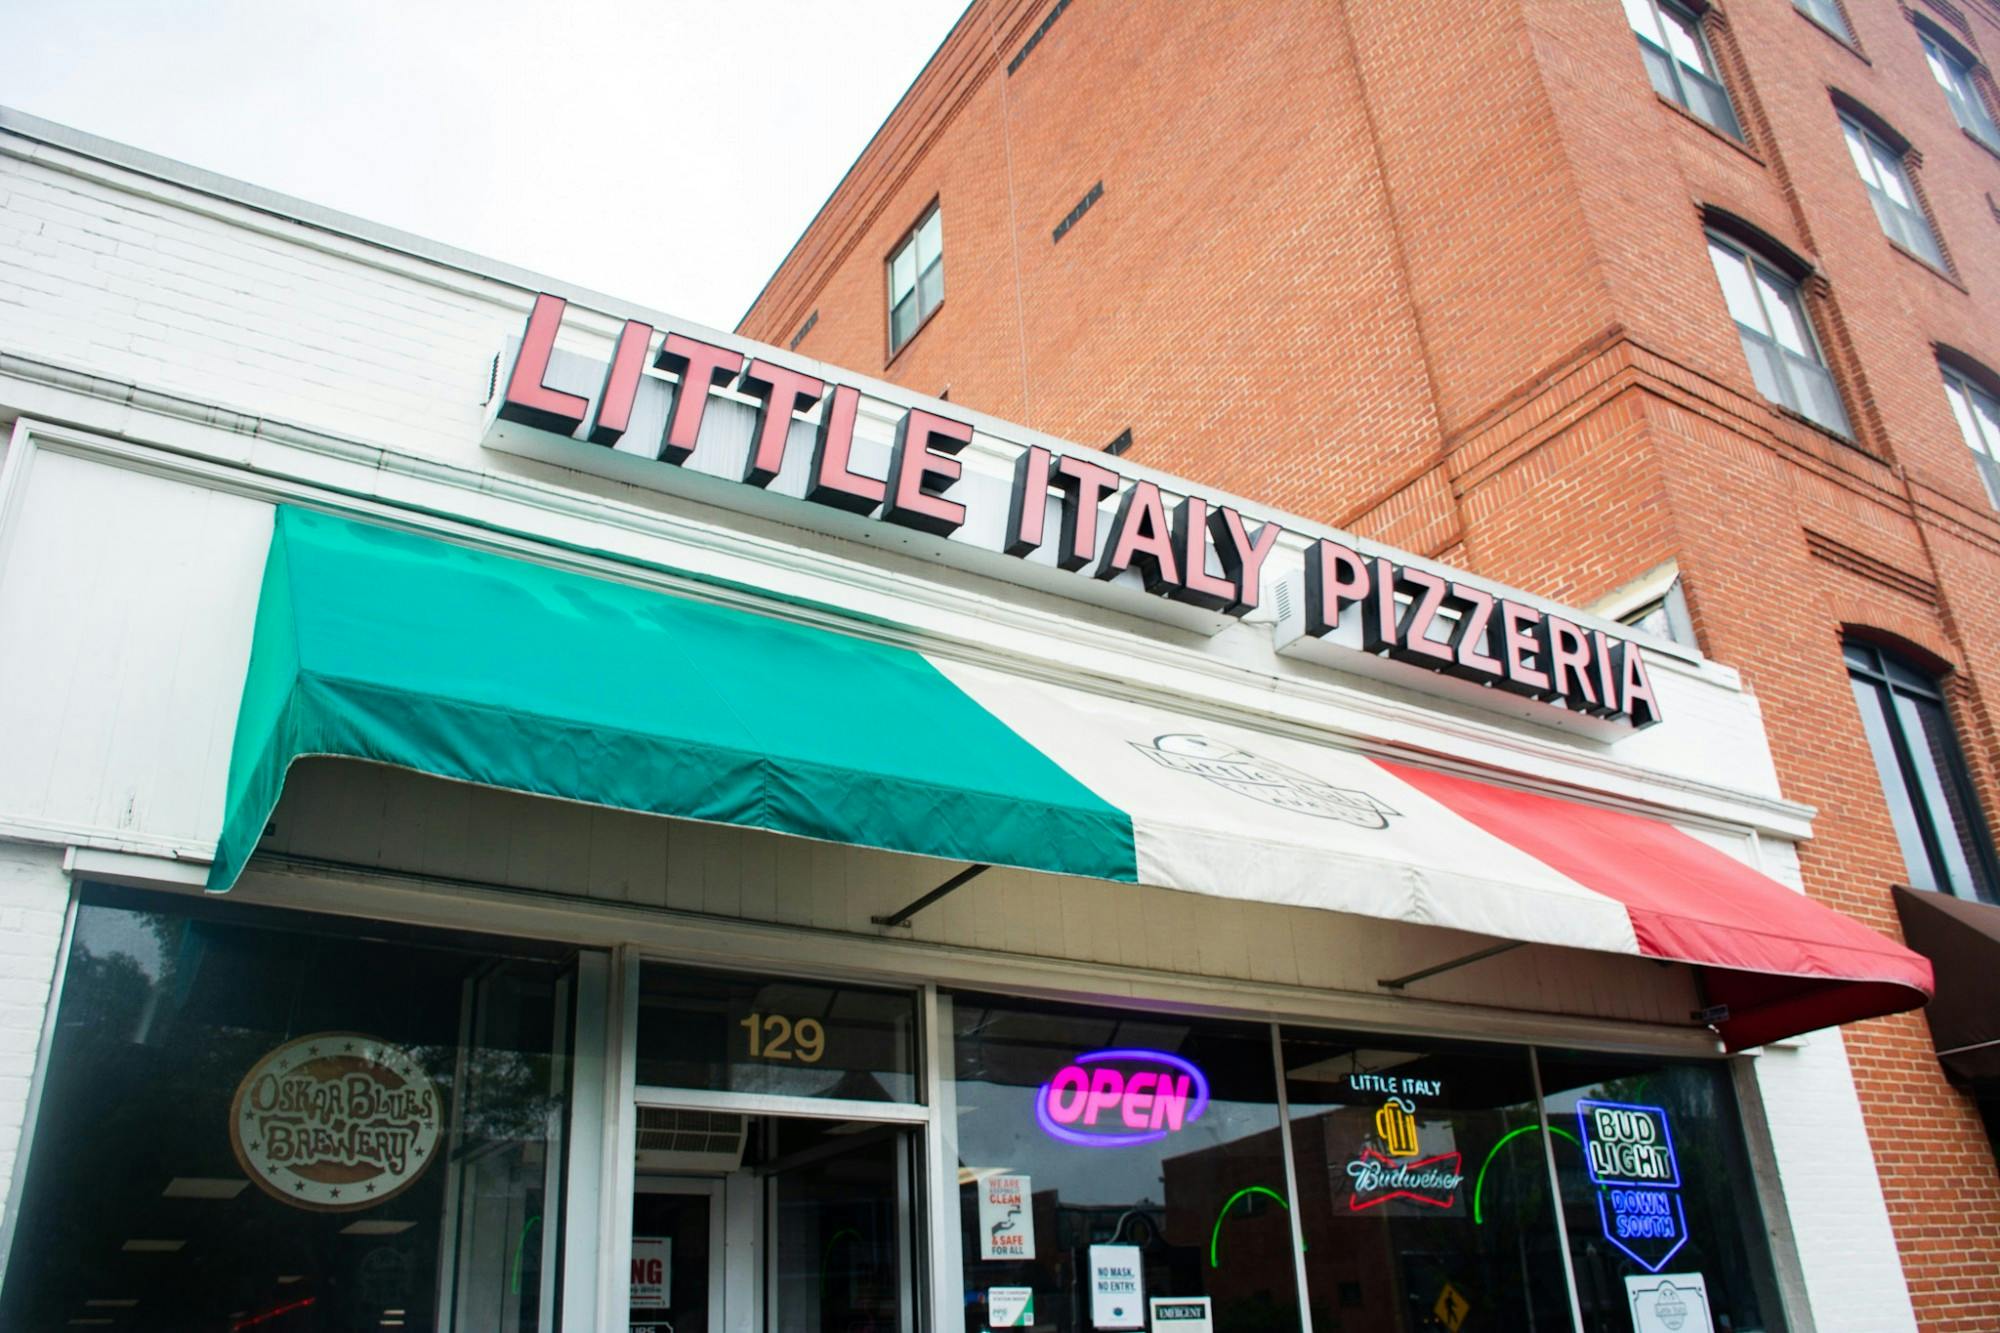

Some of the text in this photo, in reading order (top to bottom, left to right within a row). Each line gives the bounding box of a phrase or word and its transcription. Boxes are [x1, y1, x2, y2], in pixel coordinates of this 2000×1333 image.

[503, 291, 1663, 728] LITTLE ITALY PIZZERIA
[740, 1013, 826, 1063] 129
[250, 1073, 433, 1123] OSKAR BLUES
[1047, 1065, 1191, 1132] OPEN
[1350, 1074, 1441, 1096] LITTLE ITALY
[1595, 1108, 1655, 1144] BUD
[265, 1123, 410, 1176] BREWERY
[1590, 1141, 1671, 1178] LIGHT
[1346, 1160, 1464, 1191] Budweiser
[990, 1194, 1021, 1204] CLEAN
[1611, 1190, 1671, 1215] DOWN
[1000, 1235, 1024, 1246] SAFE
[1616, 1215, 1675, 1238] SOUTH
[992, 1246, 1024, 1255] FOR ALL
[1097, 1267, 1109, 1277] NO
[1097, 1281, 1109, 1291] NO
